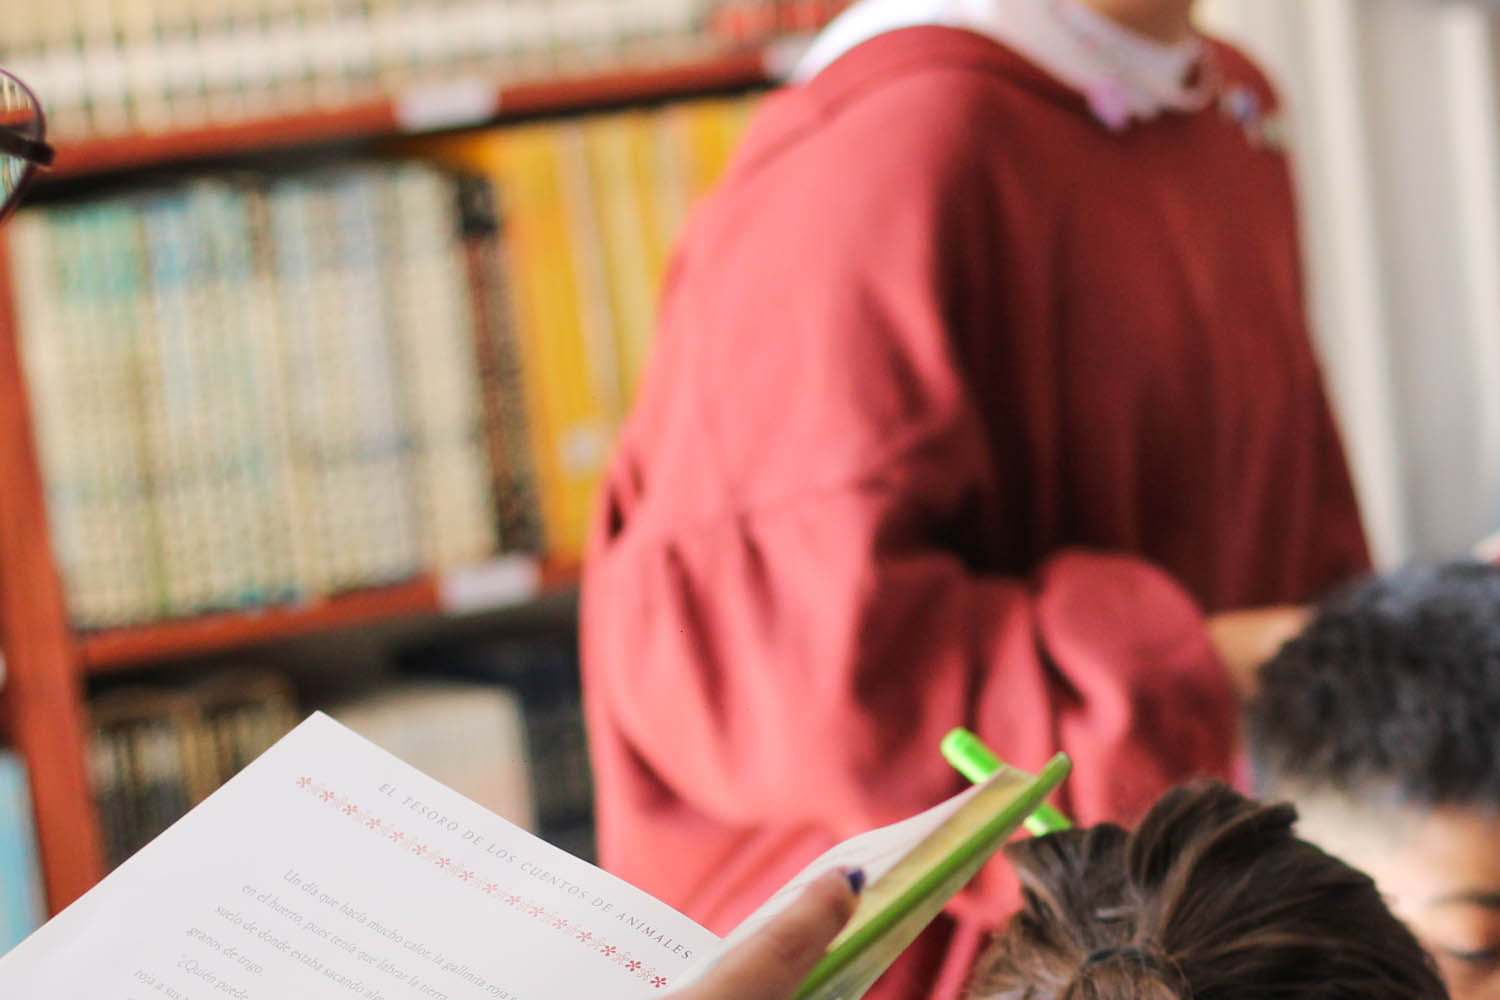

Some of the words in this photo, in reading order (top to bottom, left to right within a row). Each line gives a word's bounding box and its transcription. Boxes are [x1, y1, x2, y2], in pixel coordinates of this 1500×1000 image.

[401, 795, 459, 832] TESORO
[485, 843, 517, 864] LOS
[520, 861, 587, 900] CUENTOS
[616, 912, 693, 960] ANIMALES
[185, 928, 223, 951] granos
[214, 905, 243, 925] suelo
[257, 929, 292, 952] donde
[290, 949, 325, 971] estaba
[323, 967, 365, 993] sacando
[301, 881, 319, 896] día
[318, 893, 339, 908] que
[338, 901, 368, 923] hacía
[366, 920, 404, 943] mucho
[442, 962, 486, 989] gallinita
[486, 985, 509, 1000] roja
[303, 921, 331, 939] pues
[330, 935, 358, 954] tenía
[356, 950, 377, 965] que
[376, 958, 409, 981] labrar
[133, 971, 156, 986] roja
[164, 988, 181, 1000] sus
